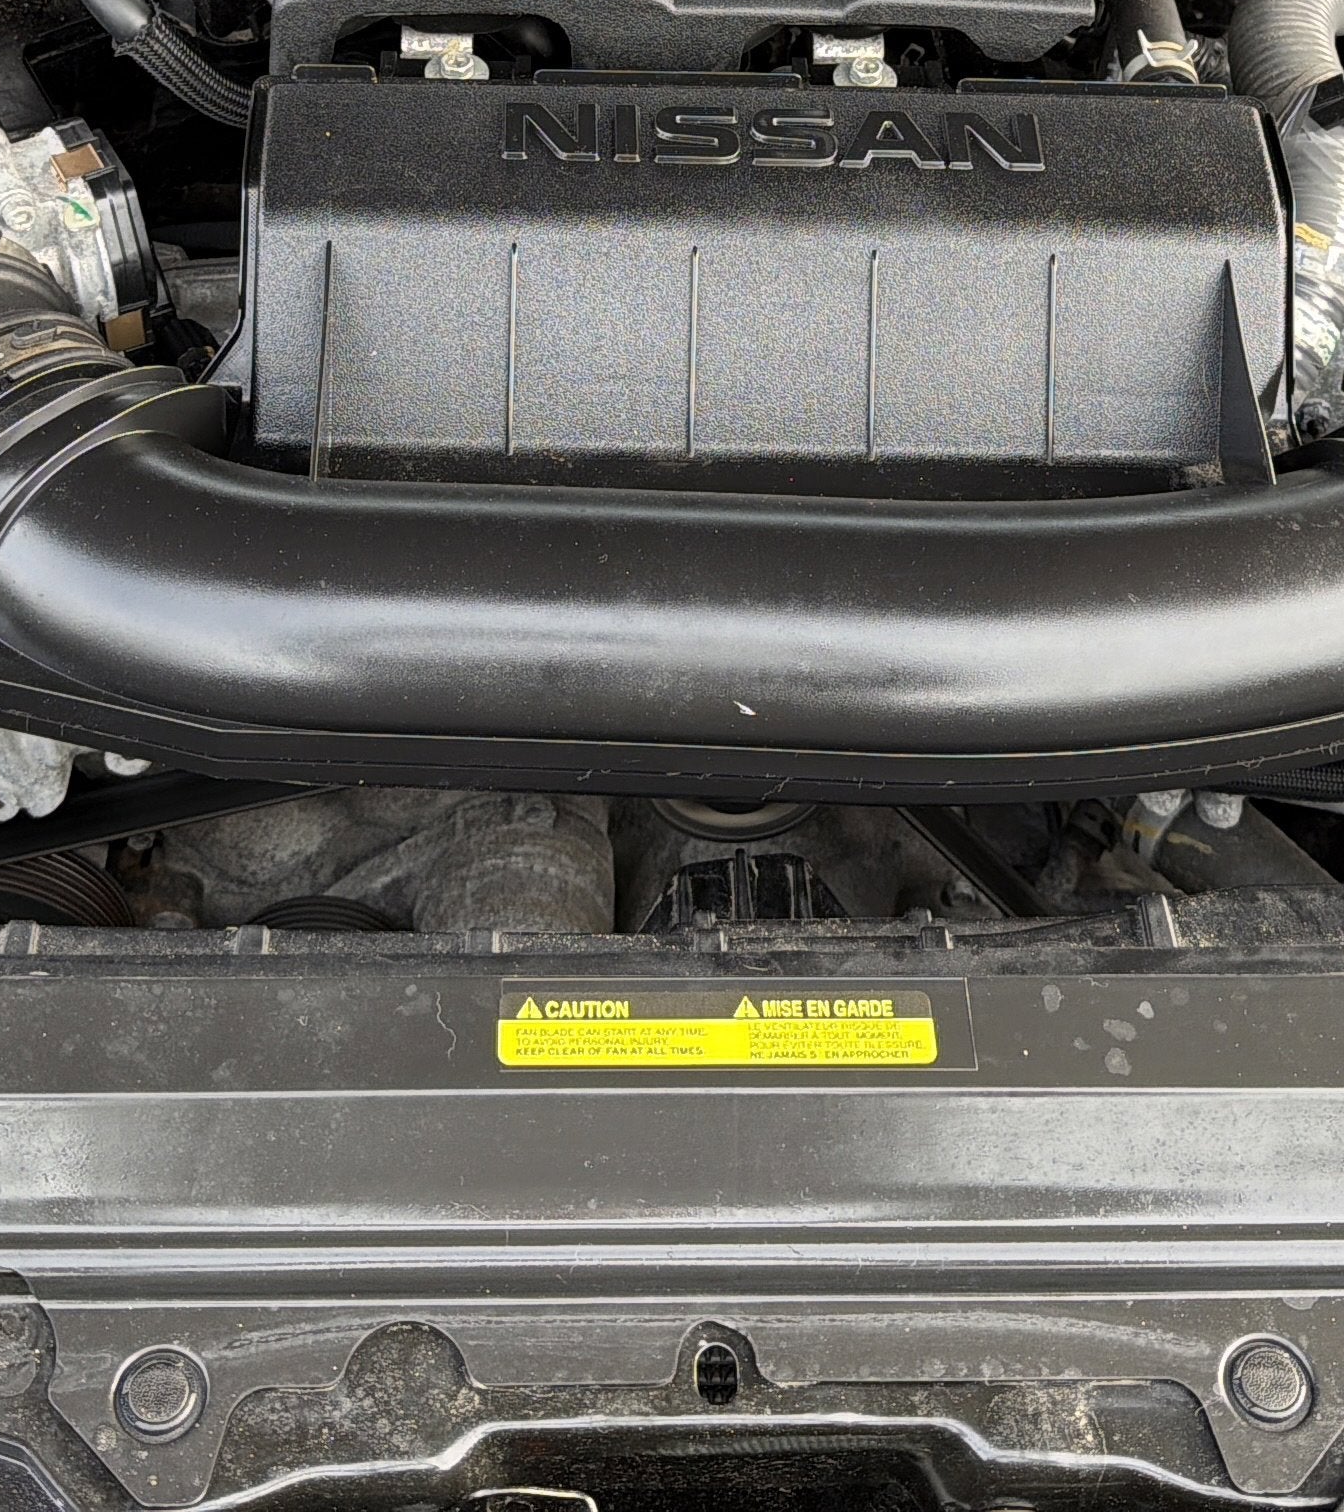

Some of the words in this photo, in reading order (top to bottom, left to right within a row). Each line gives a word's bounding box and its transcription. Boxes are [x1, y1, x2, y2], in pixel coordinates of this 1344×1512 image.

[502, 102, 1046, 172] NISSAN
[544, 999, 630, 1019] CAUTION
[761, 999, 804, 1018] MISE
[806, 999, 831, 1018] EN
[833, 999, 895, 1018] GARDE
[515, 1027, 538, 1037] FAN
[540, 1027, 574, 1037] BLADE
[577, 1027, 600, 1037] CAN
[603, 1027, 636, 1037] START
[516, 1037, 533, 1047] TO
[515, 1046, 545, 1056] KEEP
[547, 1046, 584, 1056] CLEAR
[588, 1046, 601, 1056] OF
[605, 1046, 627, 1056] FAN
[630, 1046, 643, 1056] AT
[646, 1046, 667, 1056] ALL
